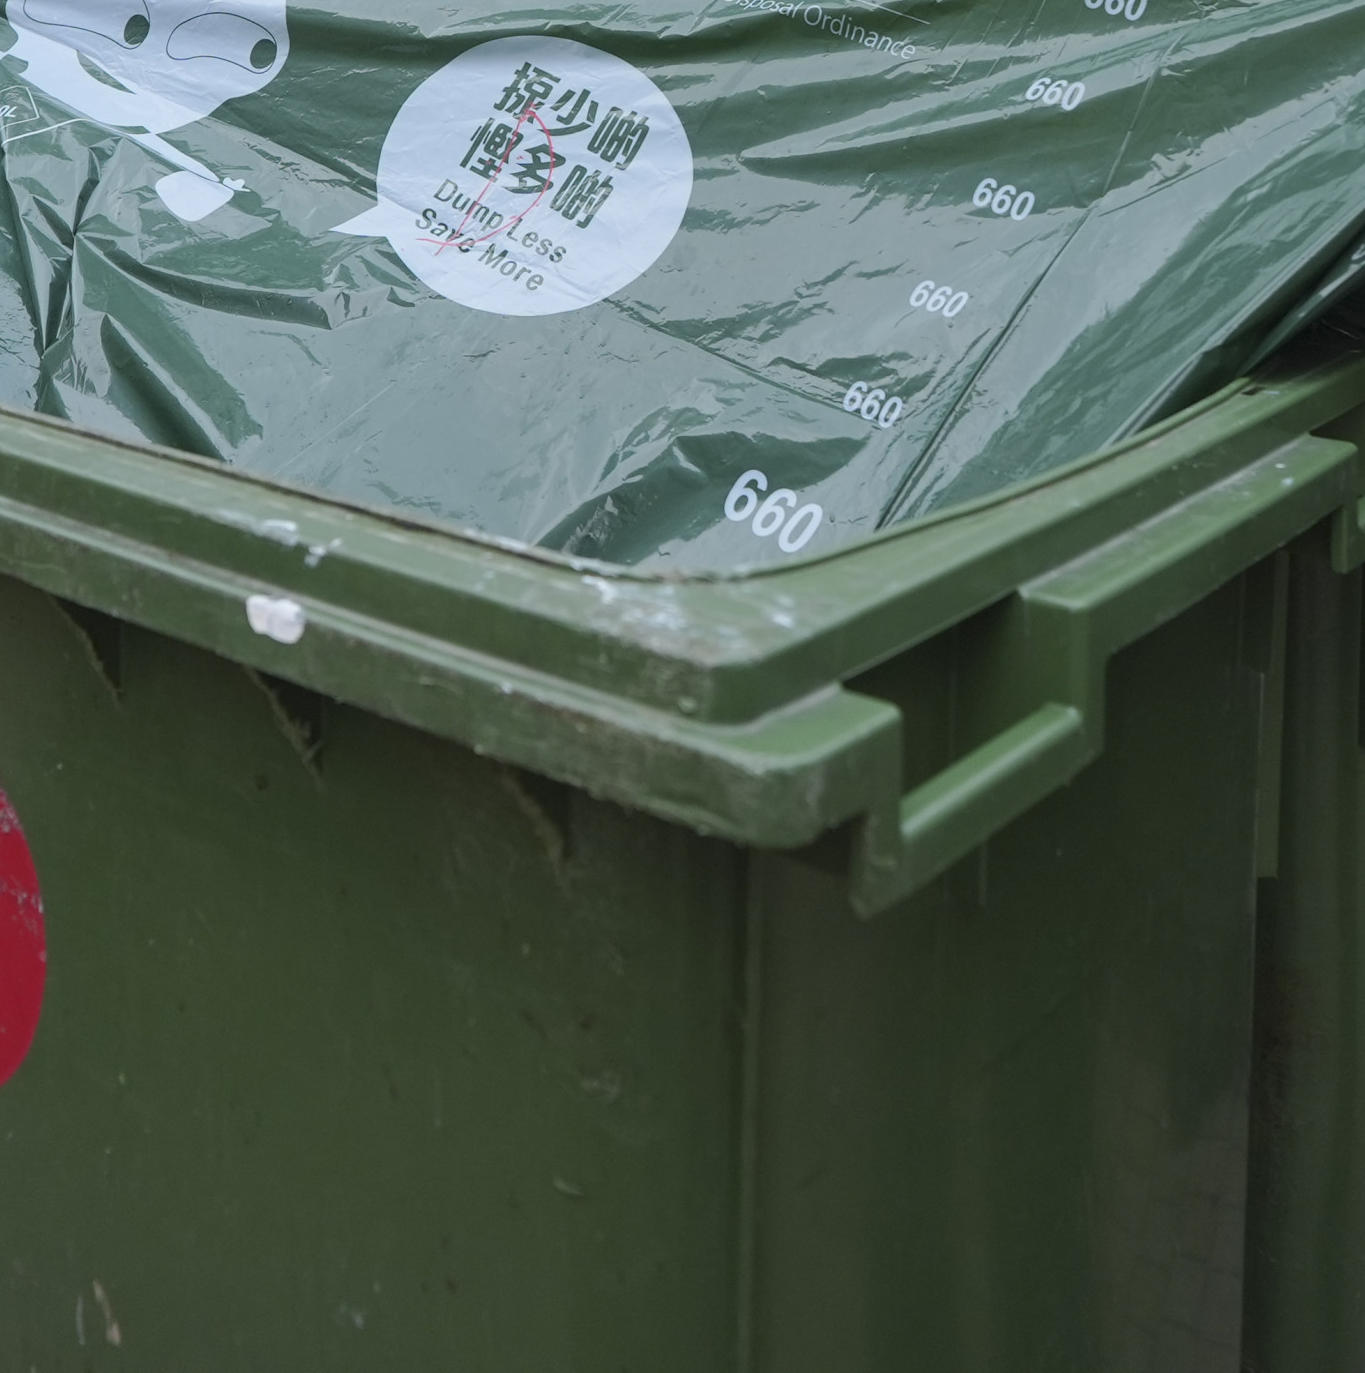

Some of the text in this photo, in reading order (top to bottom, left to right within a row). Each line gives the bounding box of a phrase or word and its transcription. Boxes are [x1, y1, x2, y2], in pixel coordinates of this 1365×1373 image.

[804, 5, 916, 60] Ordinance
[1025, 78, 1085, 111] 660
[434, 179, 567, 264] Dump Less
[973, 178, 1035, 221] 660
[415, 208, 544, 290] Save More
[909, 280, 969, 317] 660
[842, 381, 903, 428] 660
[724, 469, 823, 553] 660
